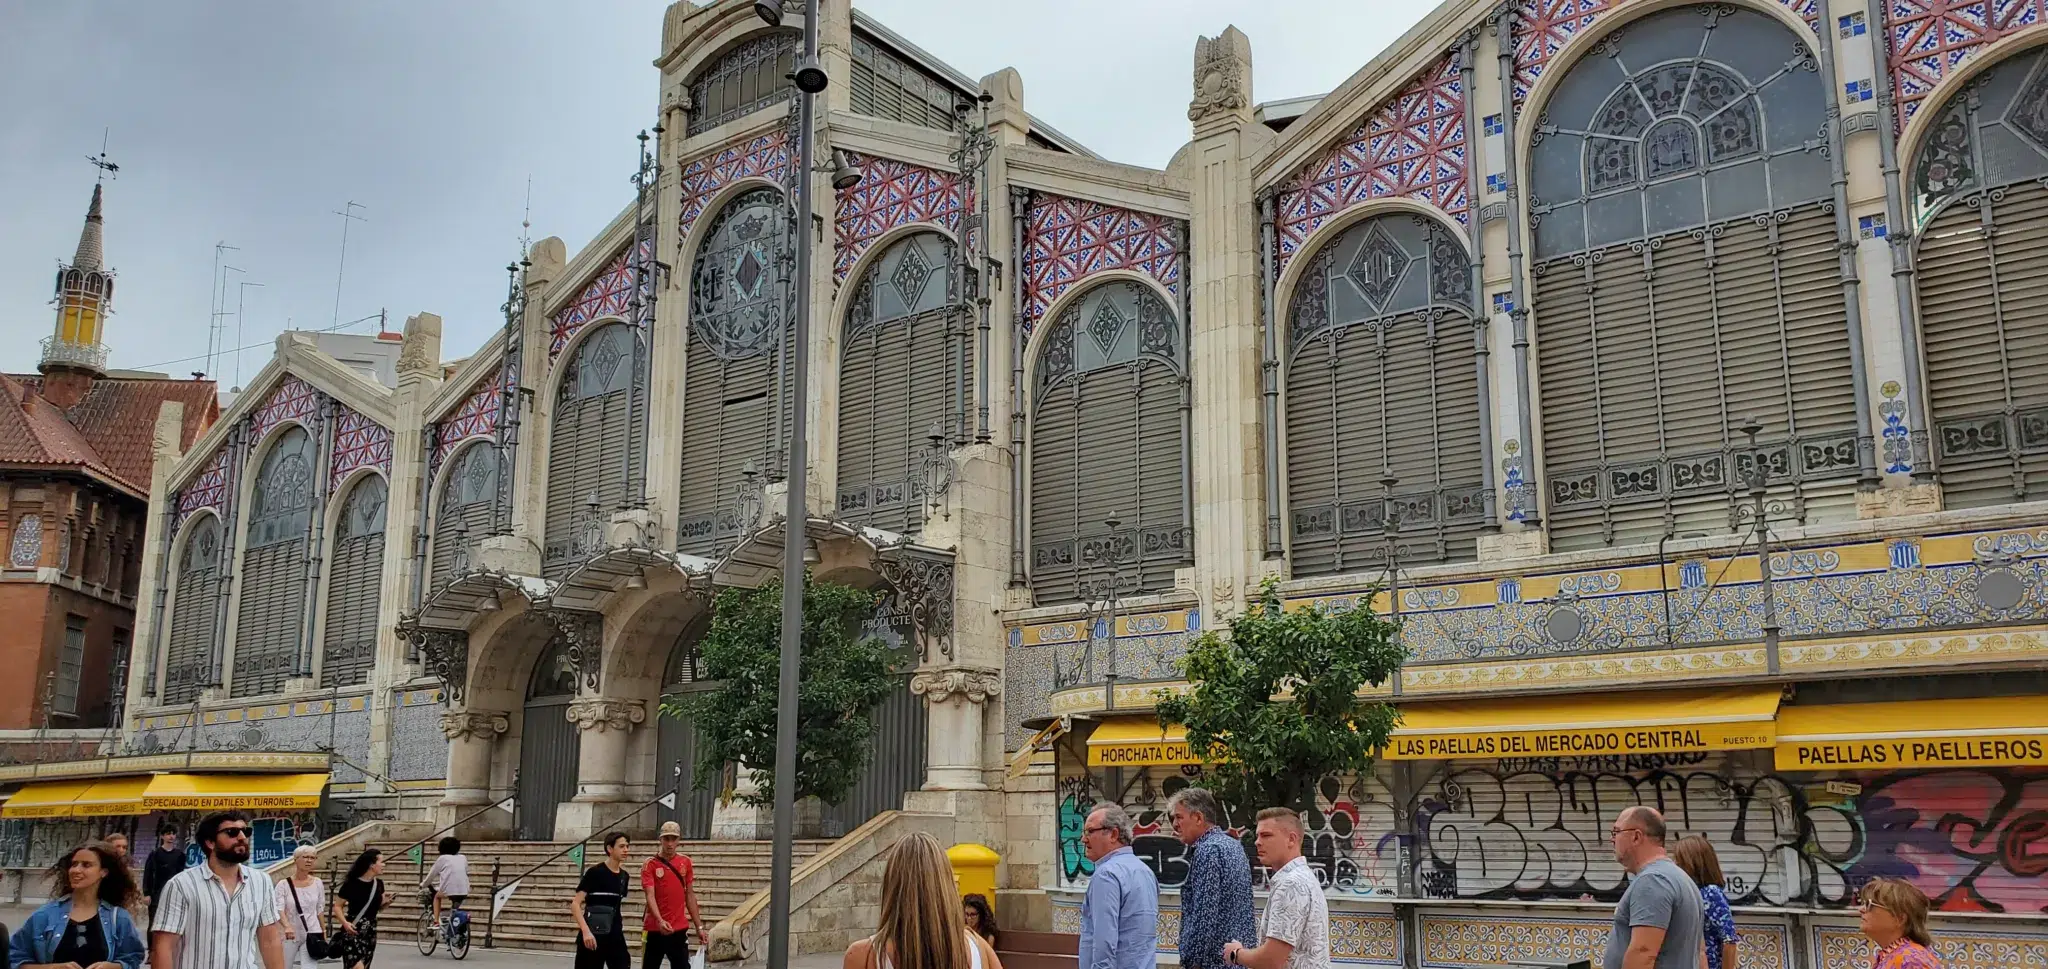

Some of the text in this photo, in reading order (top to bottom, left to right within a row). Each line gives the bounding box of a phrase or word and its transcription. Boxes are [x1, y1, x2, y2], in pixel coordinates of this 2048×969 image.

[862, 615, 911, 629] PRODUCTE
[1398, 730, 1707, 755] LAS PAELLAS DEL MERCADO CENTRAL
[1723, 736, 1755, 745] PUESTO
[1101, 746, 1162, 762] HORCHATA
[1799, 740, 2043, 764] PAELLAS Y PAELLEROS
[143, 797, 294, 807] ESPECIALIDAD EN DATILES Y TURRONES
